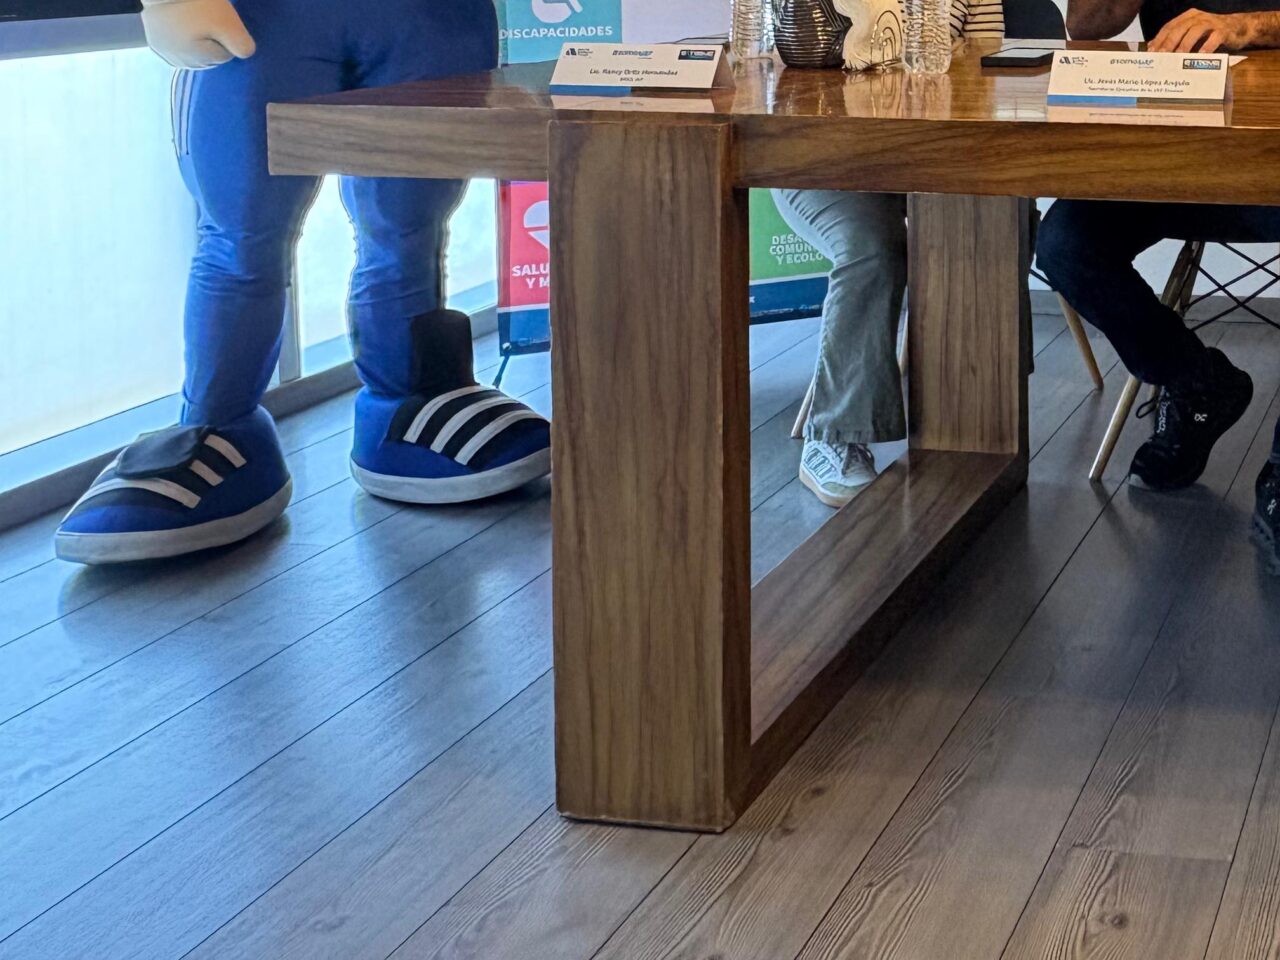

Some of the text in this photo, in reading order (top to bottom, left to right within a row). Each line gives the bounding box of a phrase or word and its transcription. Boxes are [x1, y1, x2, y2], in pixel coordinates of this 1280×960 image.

[499, 26, 613, 40] DISCAPACIDADES
[776, 252, 823, 265] Y ECOLO
[511, 263, 549, 277] SALU
[526, 277, 536, 289] Y
